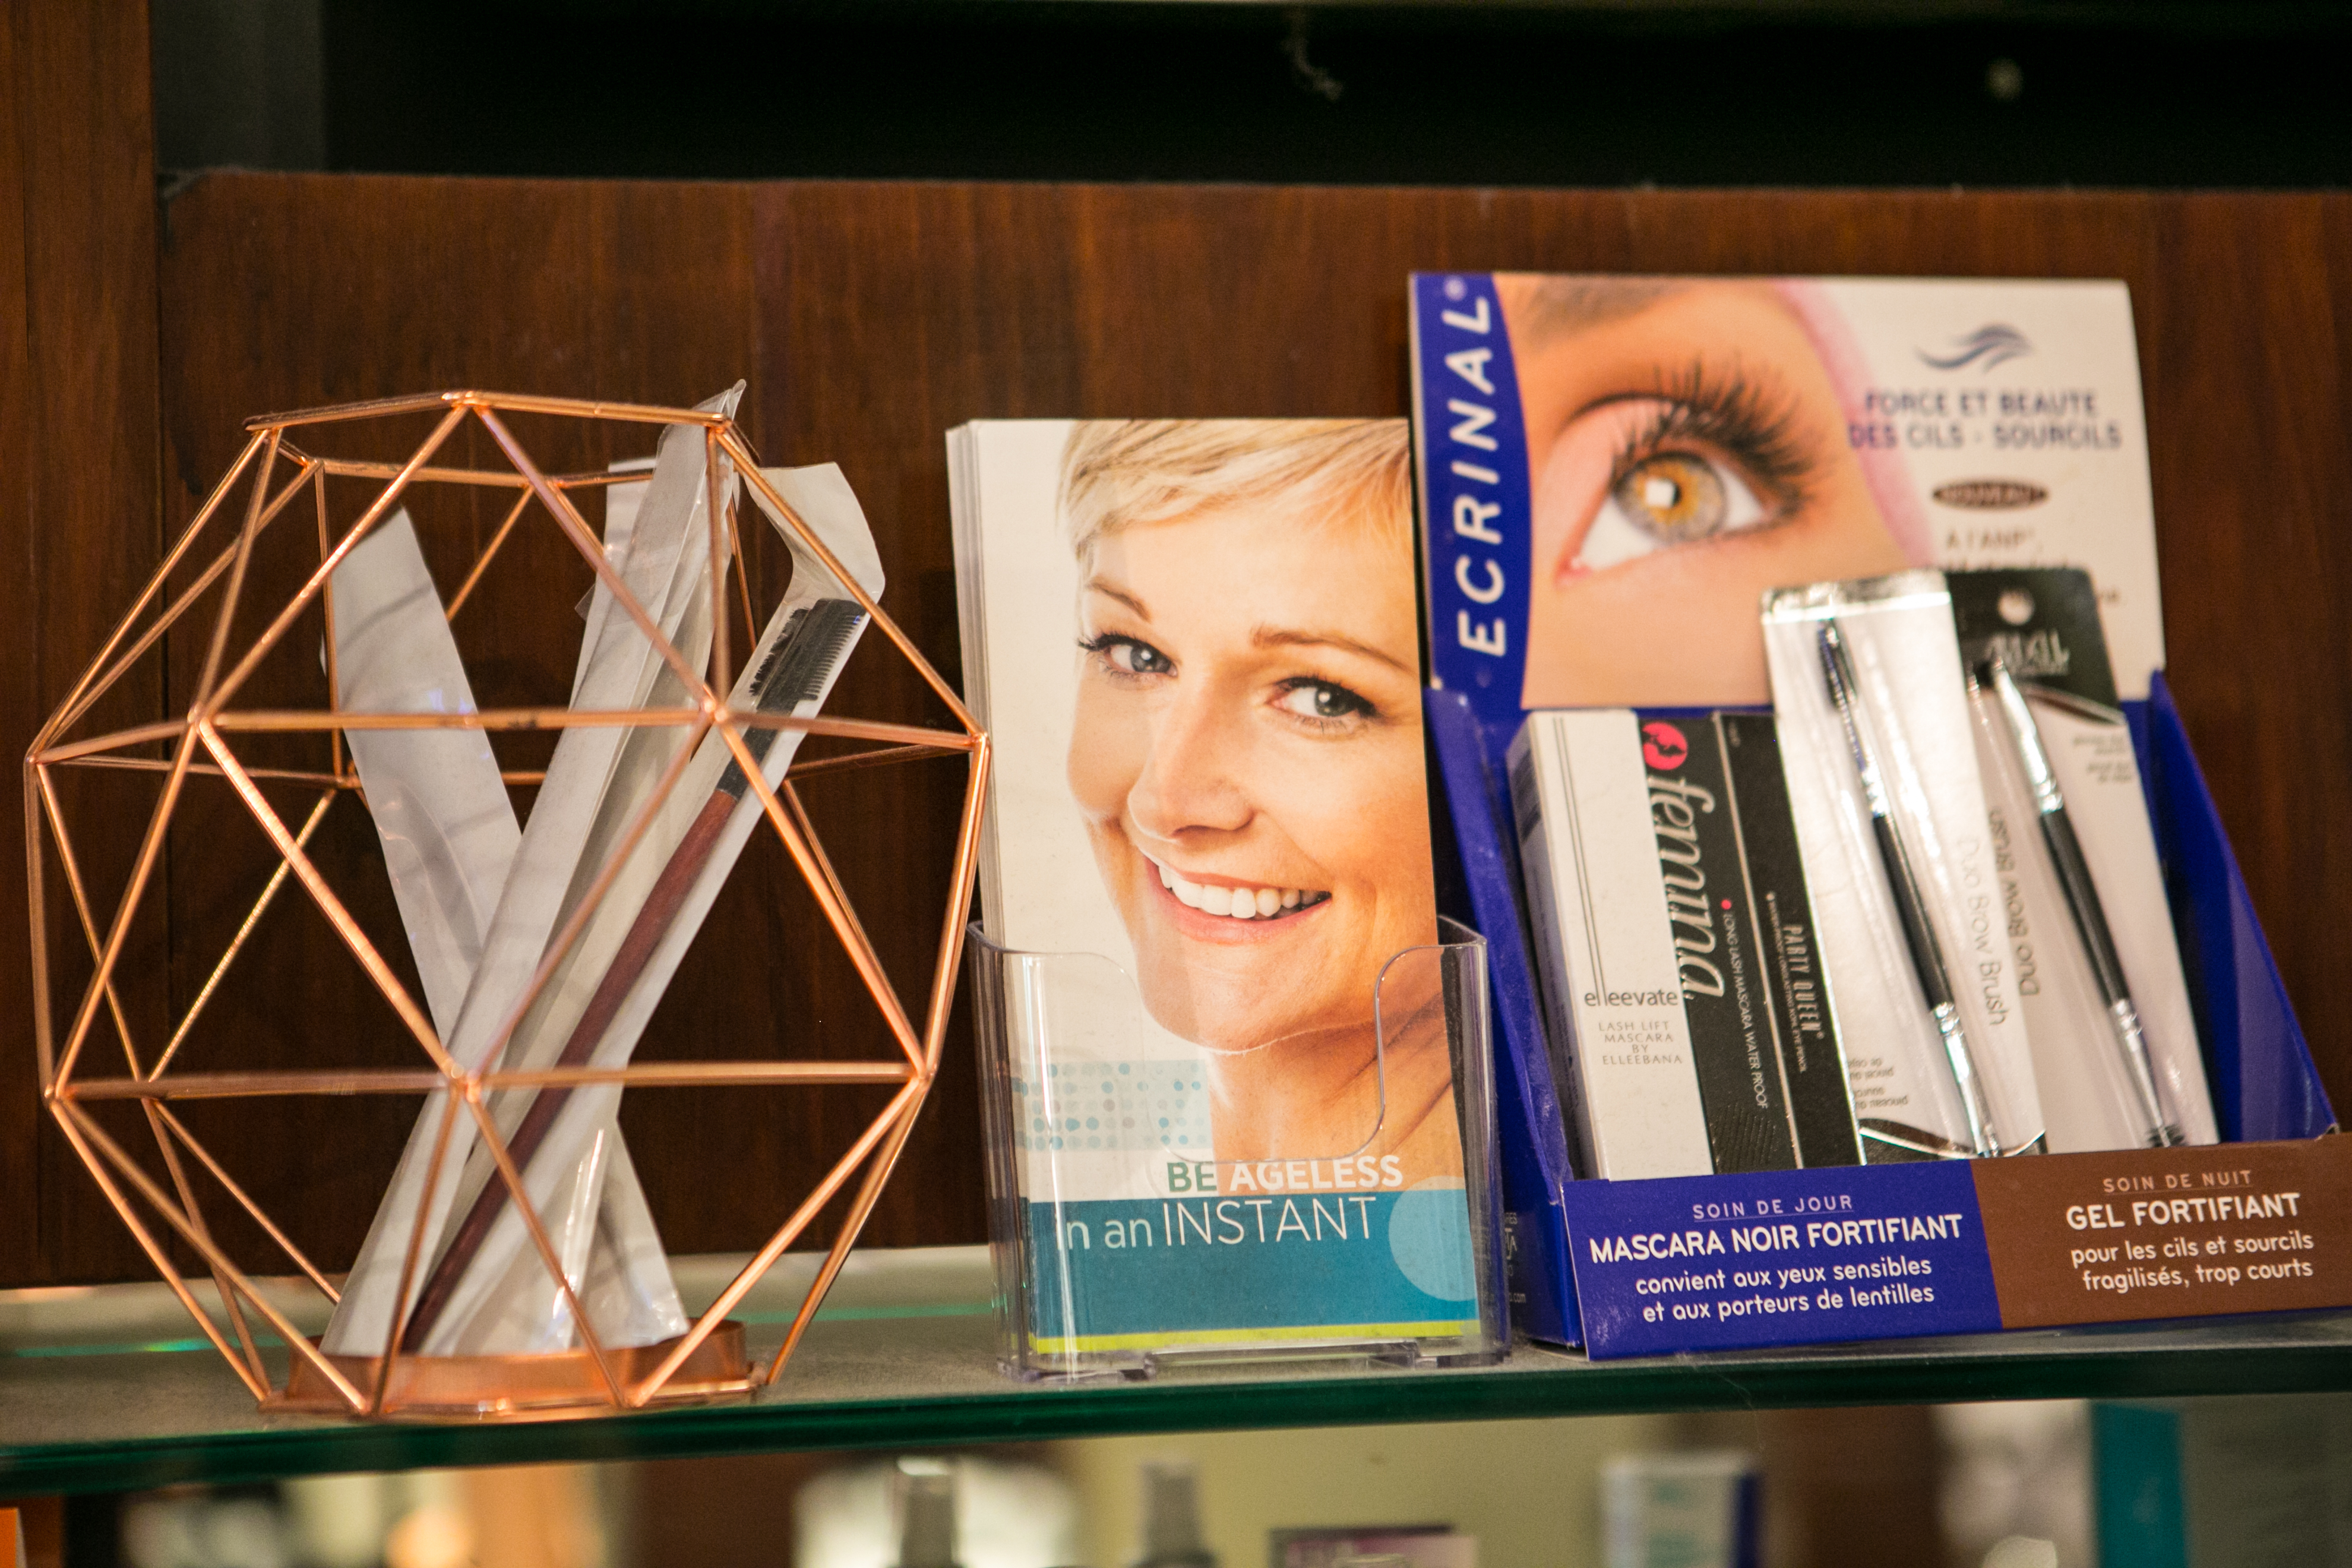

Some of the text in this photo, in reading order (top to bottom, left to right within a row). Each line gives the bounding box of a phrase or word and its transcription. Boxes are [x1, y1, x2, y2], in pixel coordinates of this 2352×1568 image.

[1865, 390, 1946, 416] FORCE
[1961, 390, 1987, 416] ET
[1849, 420, 2122, 449] DES CILS SOURCILS
[1441, 296, 1507, 657] ECRINAL
[1647, 776, 1725, 1001] femina
[1967, 896, 1993, 954] Brow
[1782, 925, 1810, 973] PARTY
[2016, 943, 2040, 997] Duo
[1584, 988, 1678, 1007] elleevate
[1723, 913, 1769, 1109] LONG LASH MASCARA WATER PROOF
[1979, 961, 2009, 1026] Brush
[1598, 1021, 1670, 1032] LASH LIFT
[1604, 1033, 1674, 1043] MASCARA
[1602, 1055, 1683, 1065] ELLEEBANA
[1632, 1044, 1649, 1054] BY
[1166, 1155, 1403, 1193] BE AGELESS
[2103, 1170, 2252, 1193] SOIN DE NUIT
[1105, 1219, 1153, 1249] an
[1163, 1196, 1376, 1247] INSTANT
[1693, 1195, 1853, 1219] SOIN DE JOUR
[2066, 1192, 2300, 1230] GEL FORTIFIANT
[1589, 1213, 1963, 1263] MASCARA NOIR FORTIFIANT
[2070, 1230, 2315, 1269] pour les cils et sourcils
[1636, 1256, 1932, 1295] convient aux yeux sensibles
[2082, 1259, 2314, 1294] fragilisés, trop courts
[1643, 1284, 1935, 1323] et aux porteurs de lentilles
